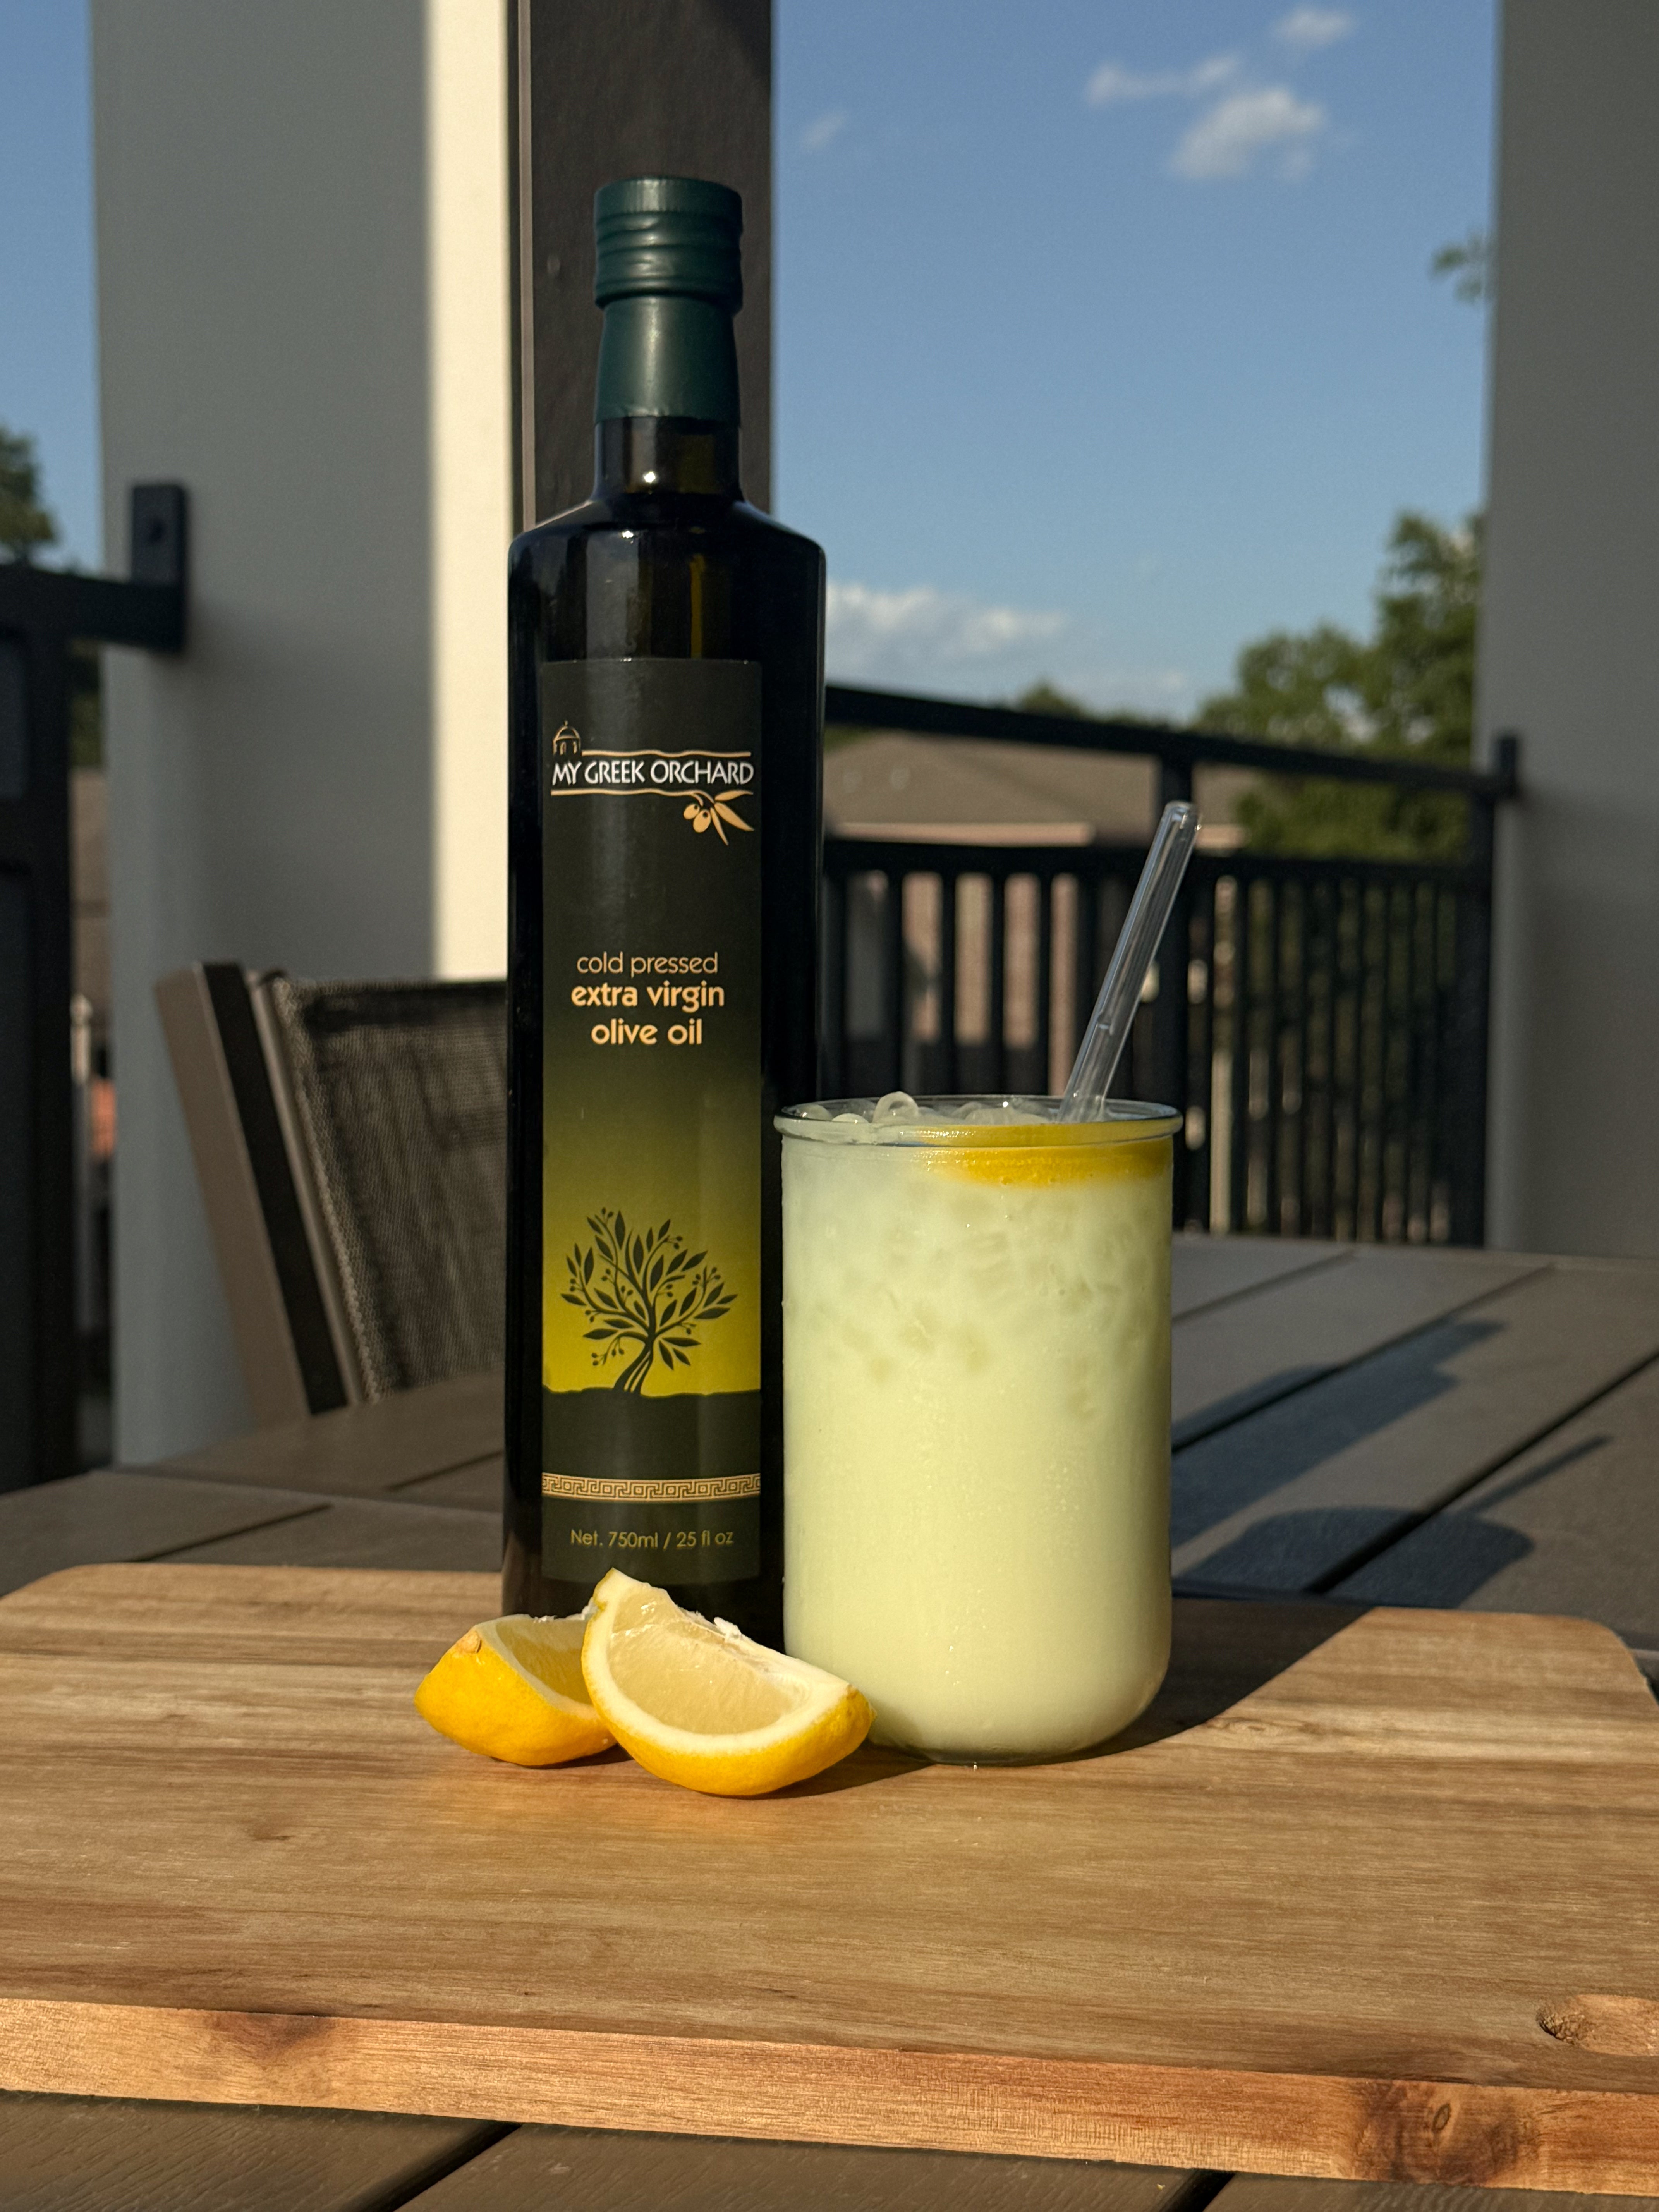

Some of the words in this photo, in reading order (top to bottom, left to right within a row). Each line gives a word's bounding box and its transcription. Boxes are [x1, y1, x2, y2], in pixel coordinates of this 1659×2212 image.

[552, 761, 582, 785] MY
[584, 760, 645, 784] GREEK
[650, 760, 754, 785] ORCHARD
[576, 951, 623, 974] cold
[630, 951, 718, 979] pressed
[571, 982, 638, 1007] extra
[646, 980, 725, 1013] virgin
[591, 1018, 658, 1045] olive
[667, 1018, 702, 1045] oil
[570, 1528, 603, 1546] Net.
[608, 1531, 658, 1548] 750ml
[663, 1532, 672, 1551] /
[676, 1531, 696, 1547] 25
[701, 1530, 711, 1546] fl
[714, 1531, 733, 1545] oz
